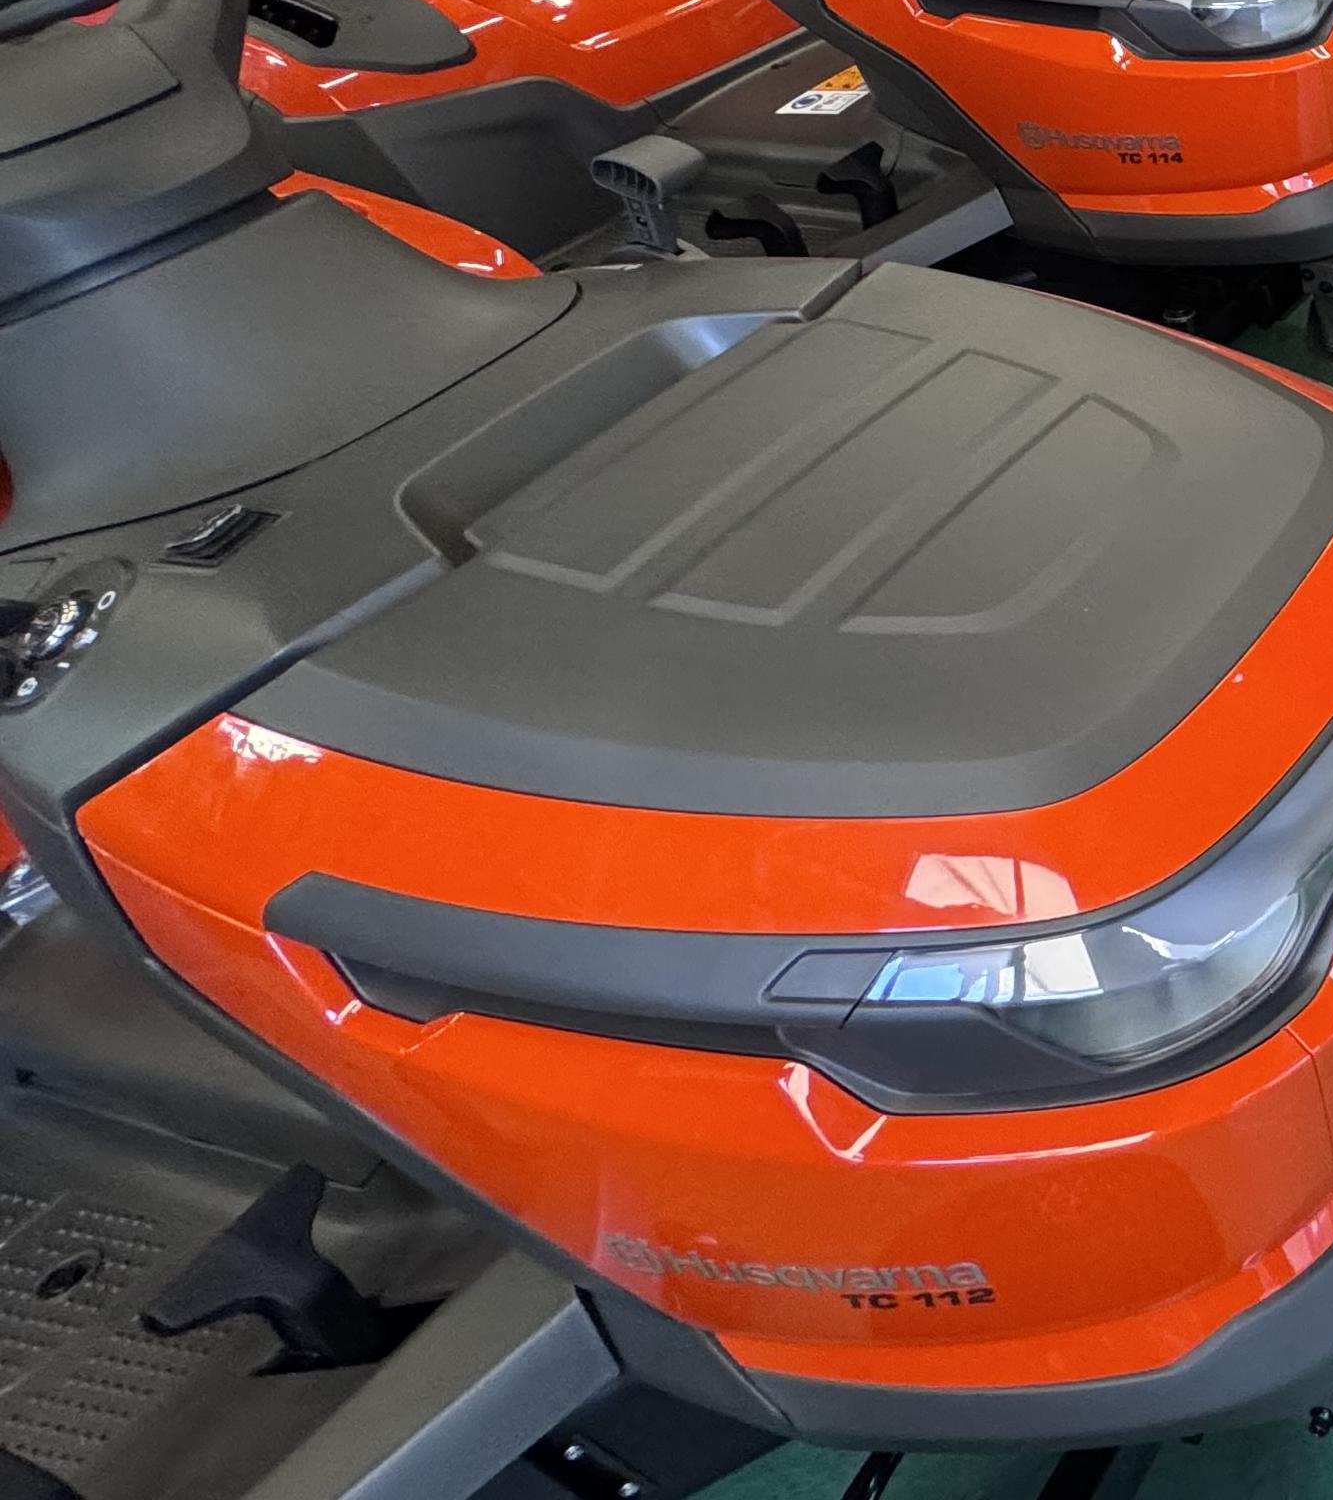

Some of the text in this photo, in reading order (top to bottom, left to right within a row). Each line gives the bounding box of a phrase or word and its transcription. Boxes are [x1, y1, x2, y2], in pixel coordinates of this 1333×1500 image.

[1050, 129, 1181, 152] Husqvarna
[1118, 152, 1184, 165] TC 114
[662, 1248, 986, 1294] Husqvarna
[842, 1288, 996, 1309] TC 112
